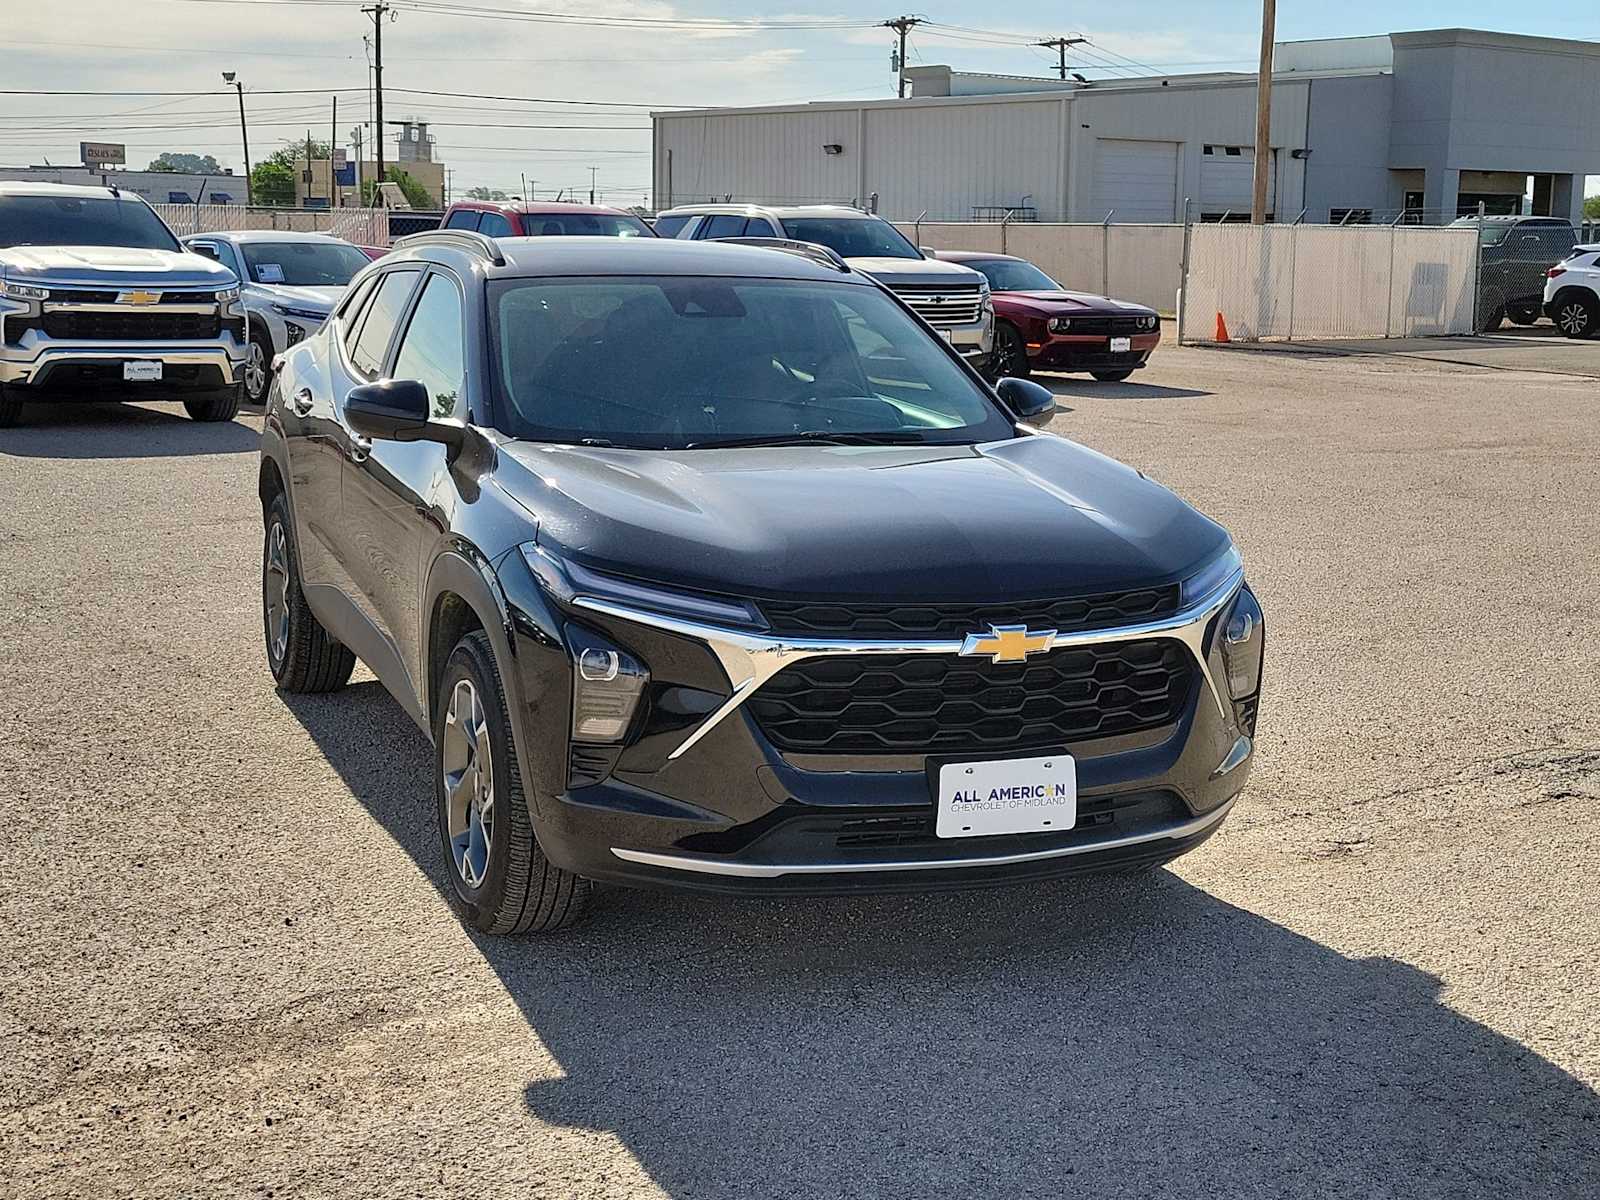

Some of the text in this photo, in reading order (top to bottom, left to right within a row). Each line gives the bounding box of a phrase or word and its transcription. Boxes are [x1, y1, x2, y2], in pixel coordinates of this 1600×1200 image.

[952, 784, 1065, 803] ALL AMERICN
[951, 797, 1066, 813] CHEVROLET OF MIDLAND
